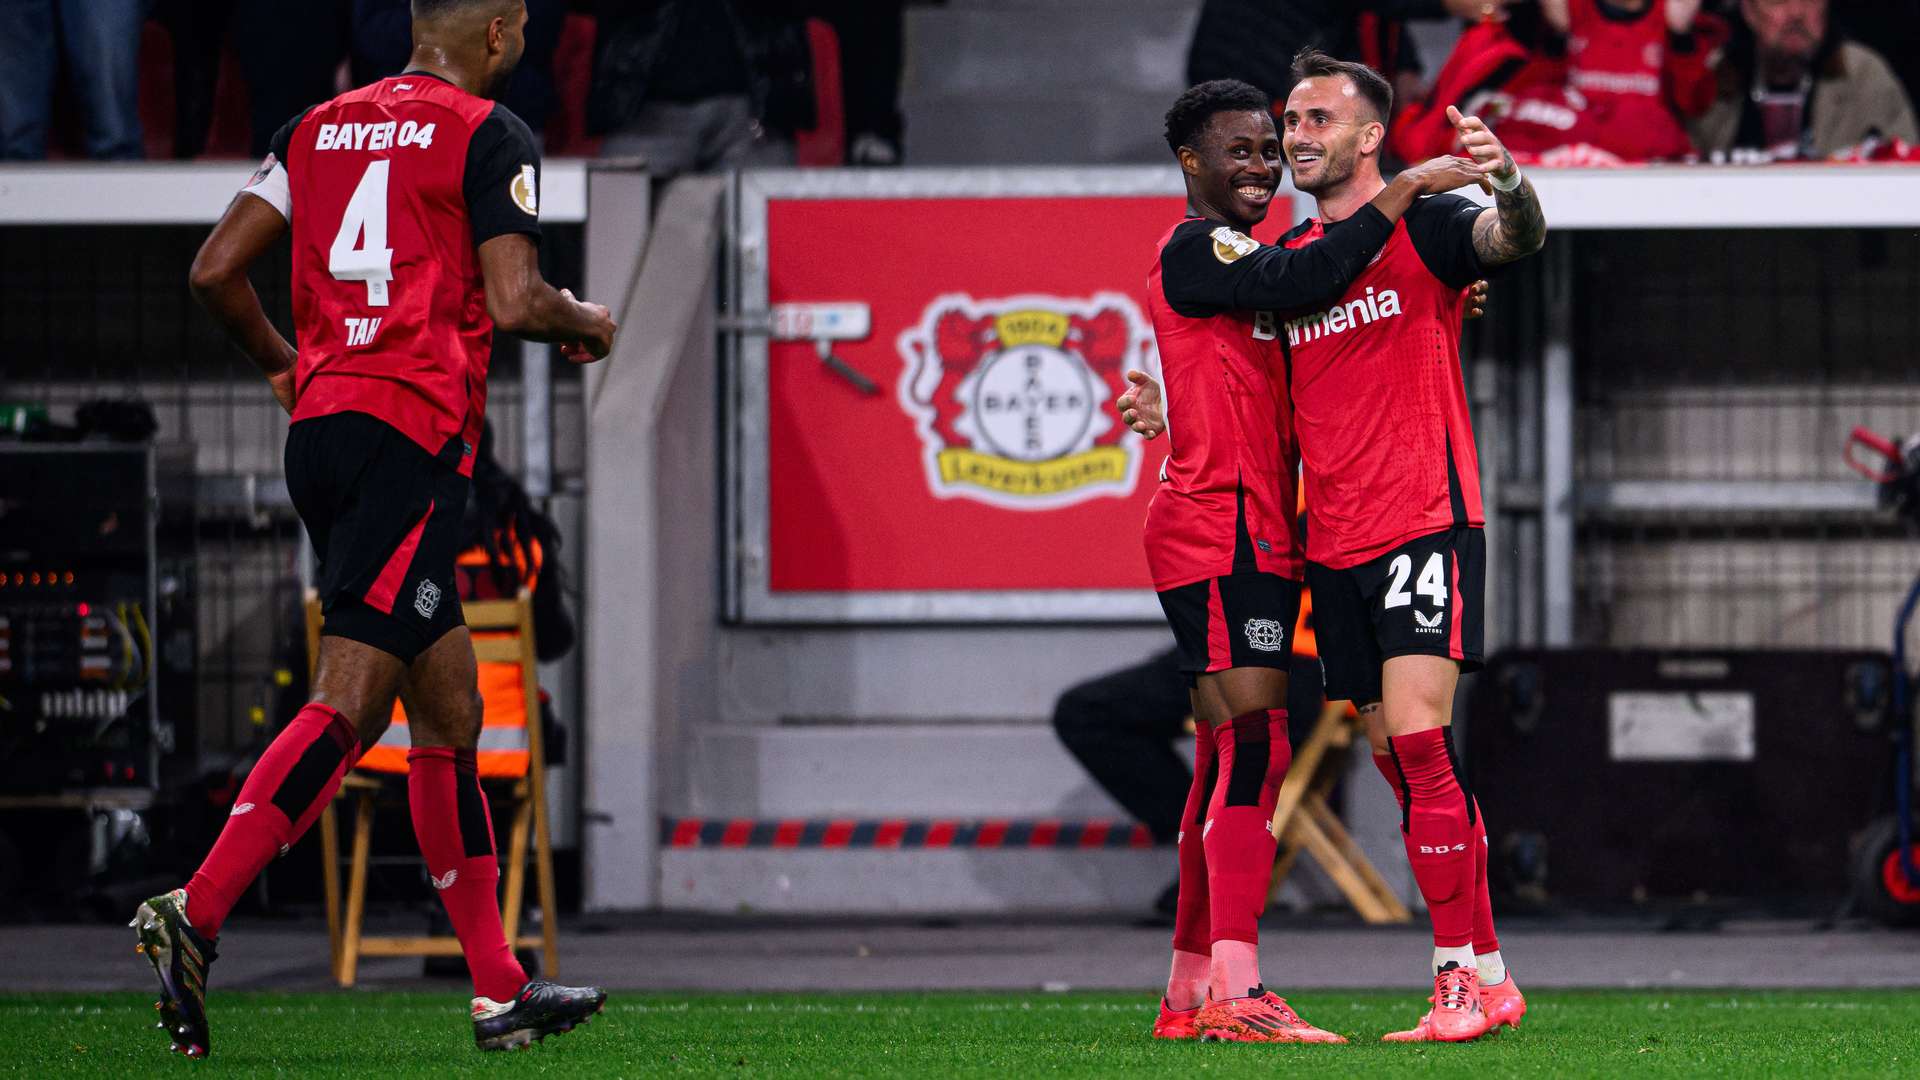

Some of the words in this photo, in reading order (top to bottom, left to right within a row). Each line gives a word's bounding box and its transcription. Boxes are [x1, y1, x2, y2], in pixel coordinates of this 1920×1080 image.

[315, 121, 397, 151] BAYER
[397, 120, 436, 149] 04
[329, 159, 394, 307] 4
[344, 317, 382, 347] TAH
[984, 395, 1083, 412] BAYER
[951, 453, 1115, 489] Leverkusen
[1384, 552, 1448, 610] 24
